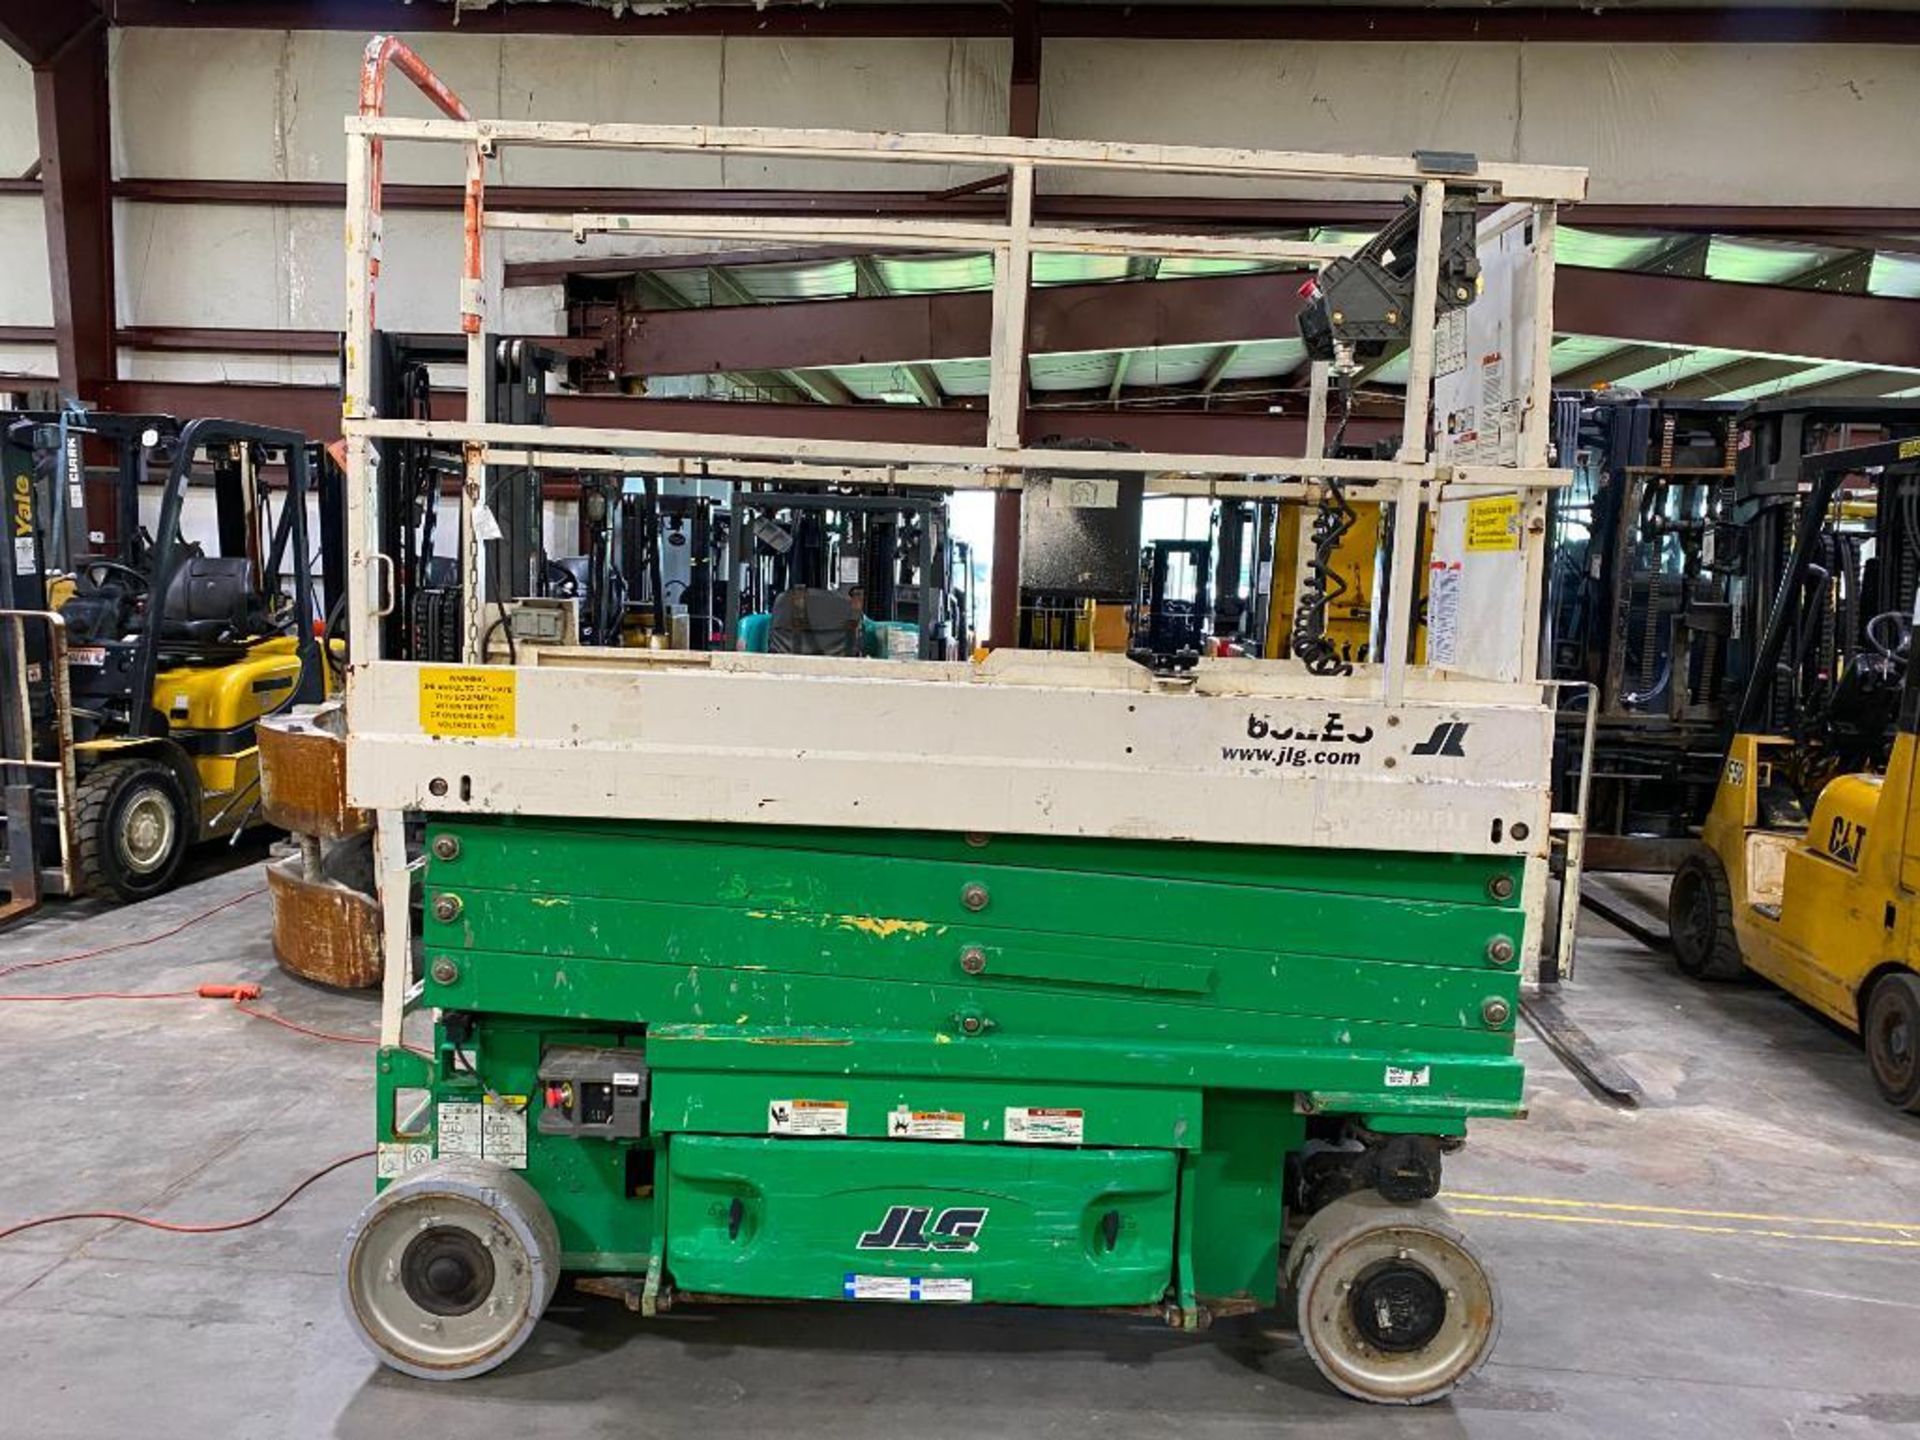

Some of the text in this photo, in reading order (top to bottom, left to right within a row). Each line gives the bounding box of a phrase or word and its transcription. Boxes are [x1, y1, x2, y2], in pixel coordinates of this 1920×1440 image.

[67, 437, 79, 482] CLARK
[14, 475, 32, 536] Yale
[1221, 746, 1361, 767] www.jlg.com
[1828, 815, 1867, 867] CAT
[856, 1206, 990, 1252] JLG
